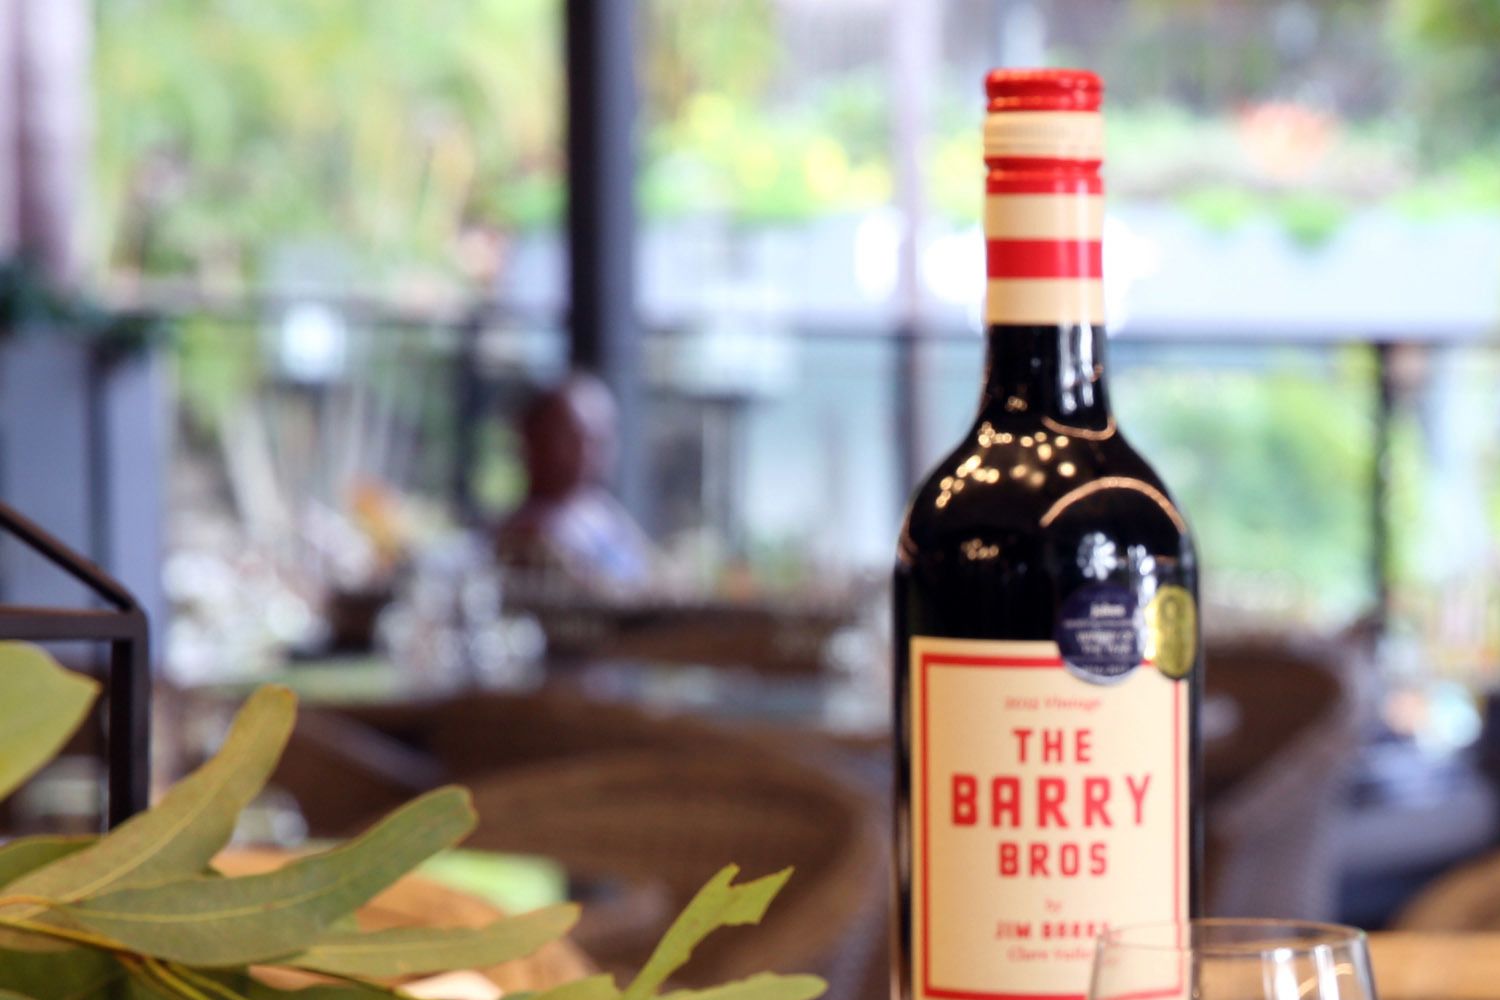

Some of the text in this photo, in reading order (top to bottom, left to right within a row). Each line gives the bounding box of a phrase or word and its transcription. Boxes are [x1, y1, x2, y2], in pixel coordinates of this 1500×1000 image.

[1012, 727, 1093, 765] THE
[949, 773, 1152, 829] BARRY
[998, 841, 1109, 878] BROS
[996, 920, 1031, 941] JIM
